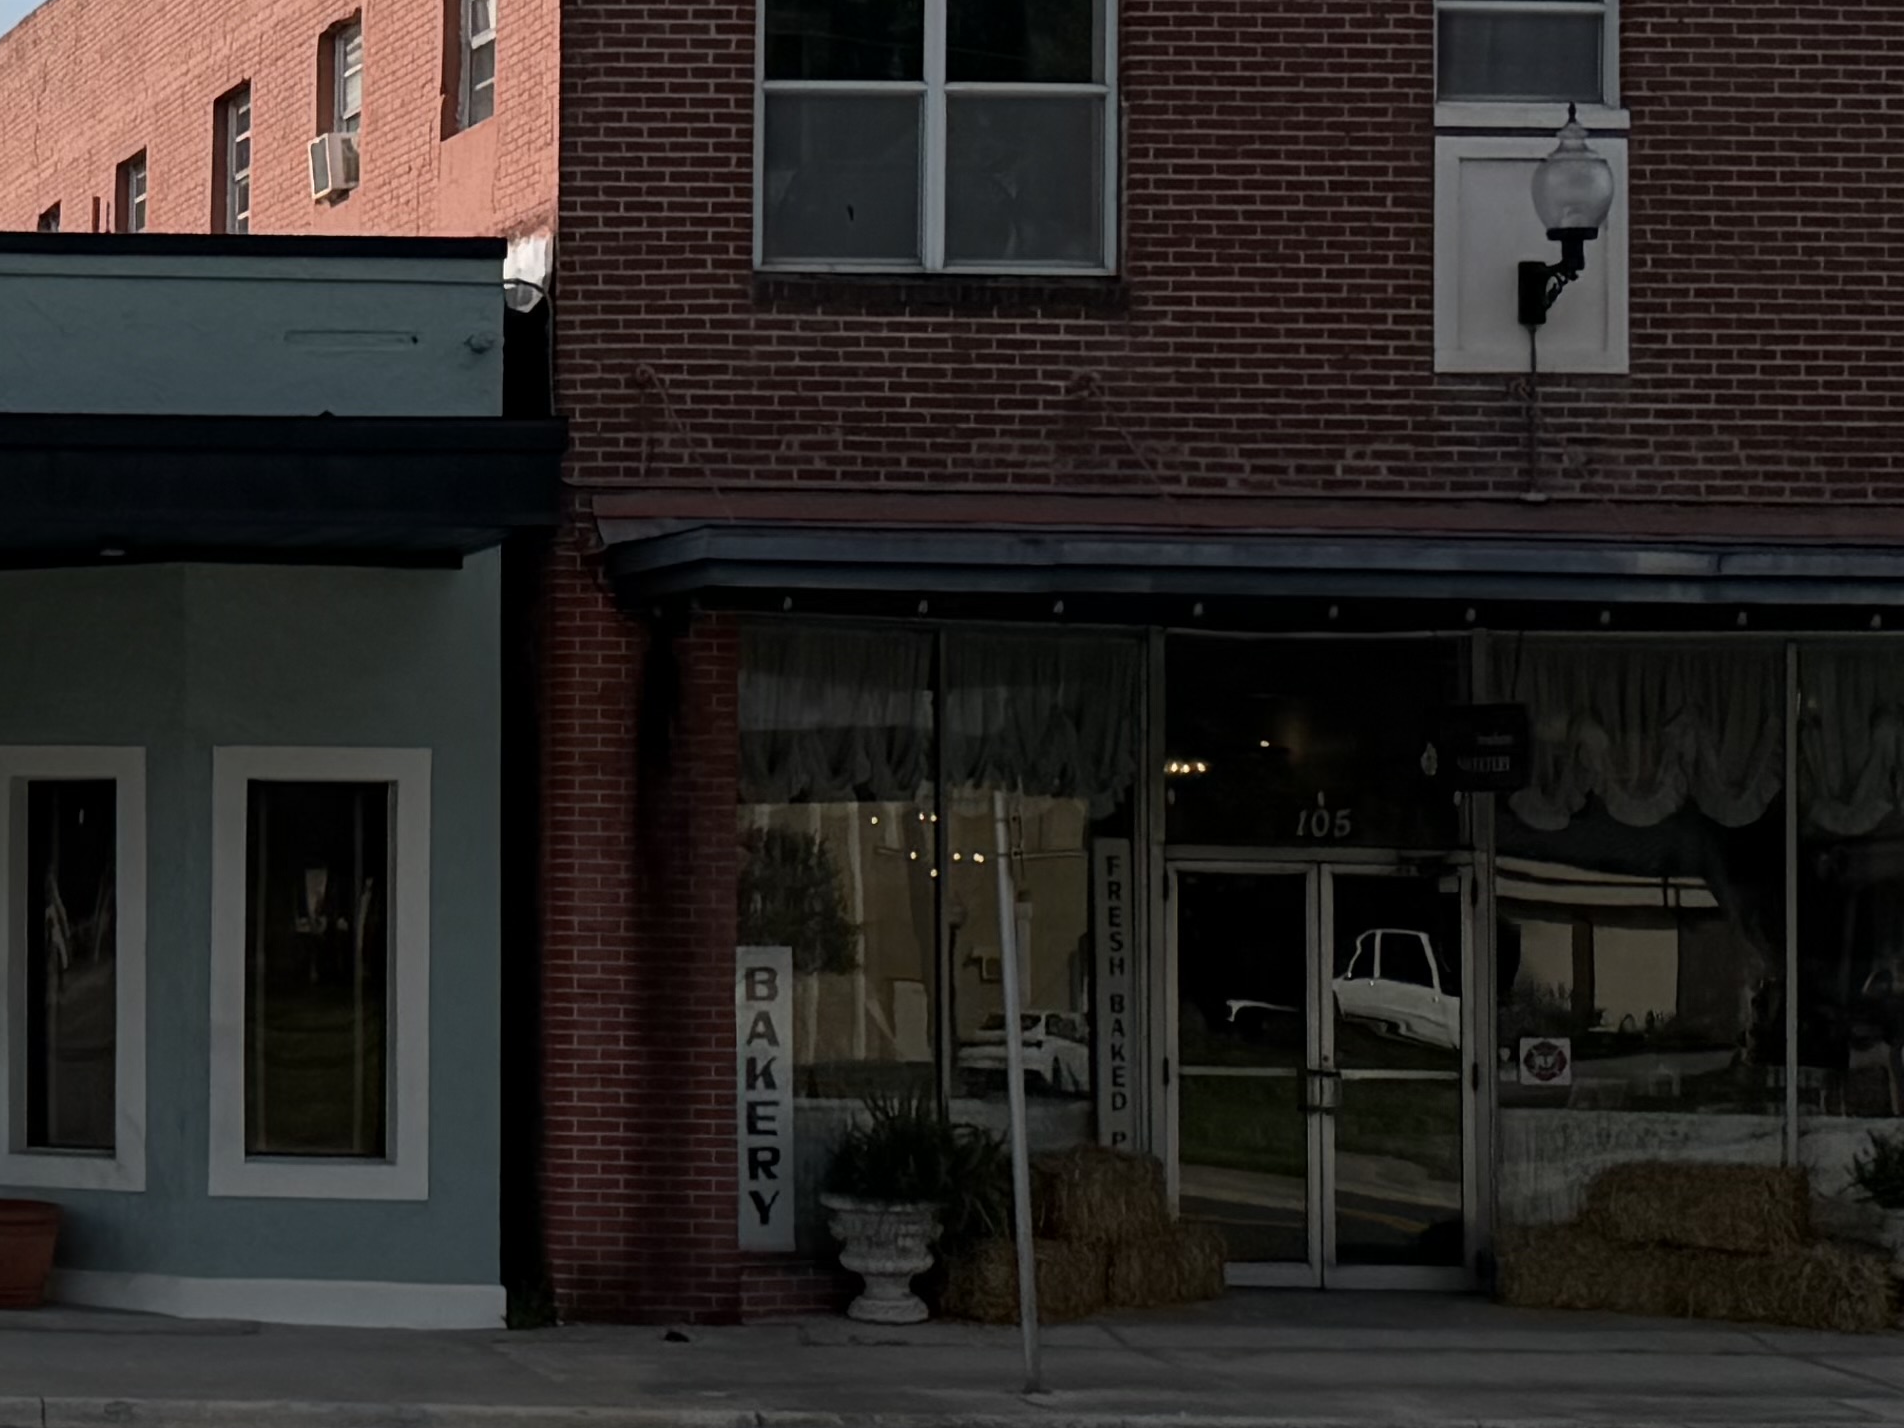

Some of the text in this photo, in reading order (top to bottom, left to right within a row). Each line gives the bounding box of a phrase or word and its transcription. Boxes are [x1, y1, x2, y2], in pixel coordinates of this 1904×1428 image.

[1295, 808, 1352, 839] 105
[1105, 855, 1126, 977] FRESH
[745, 966, 782, 1227] BAKERY
[1110, 993, 1128, 1112] BAKED
